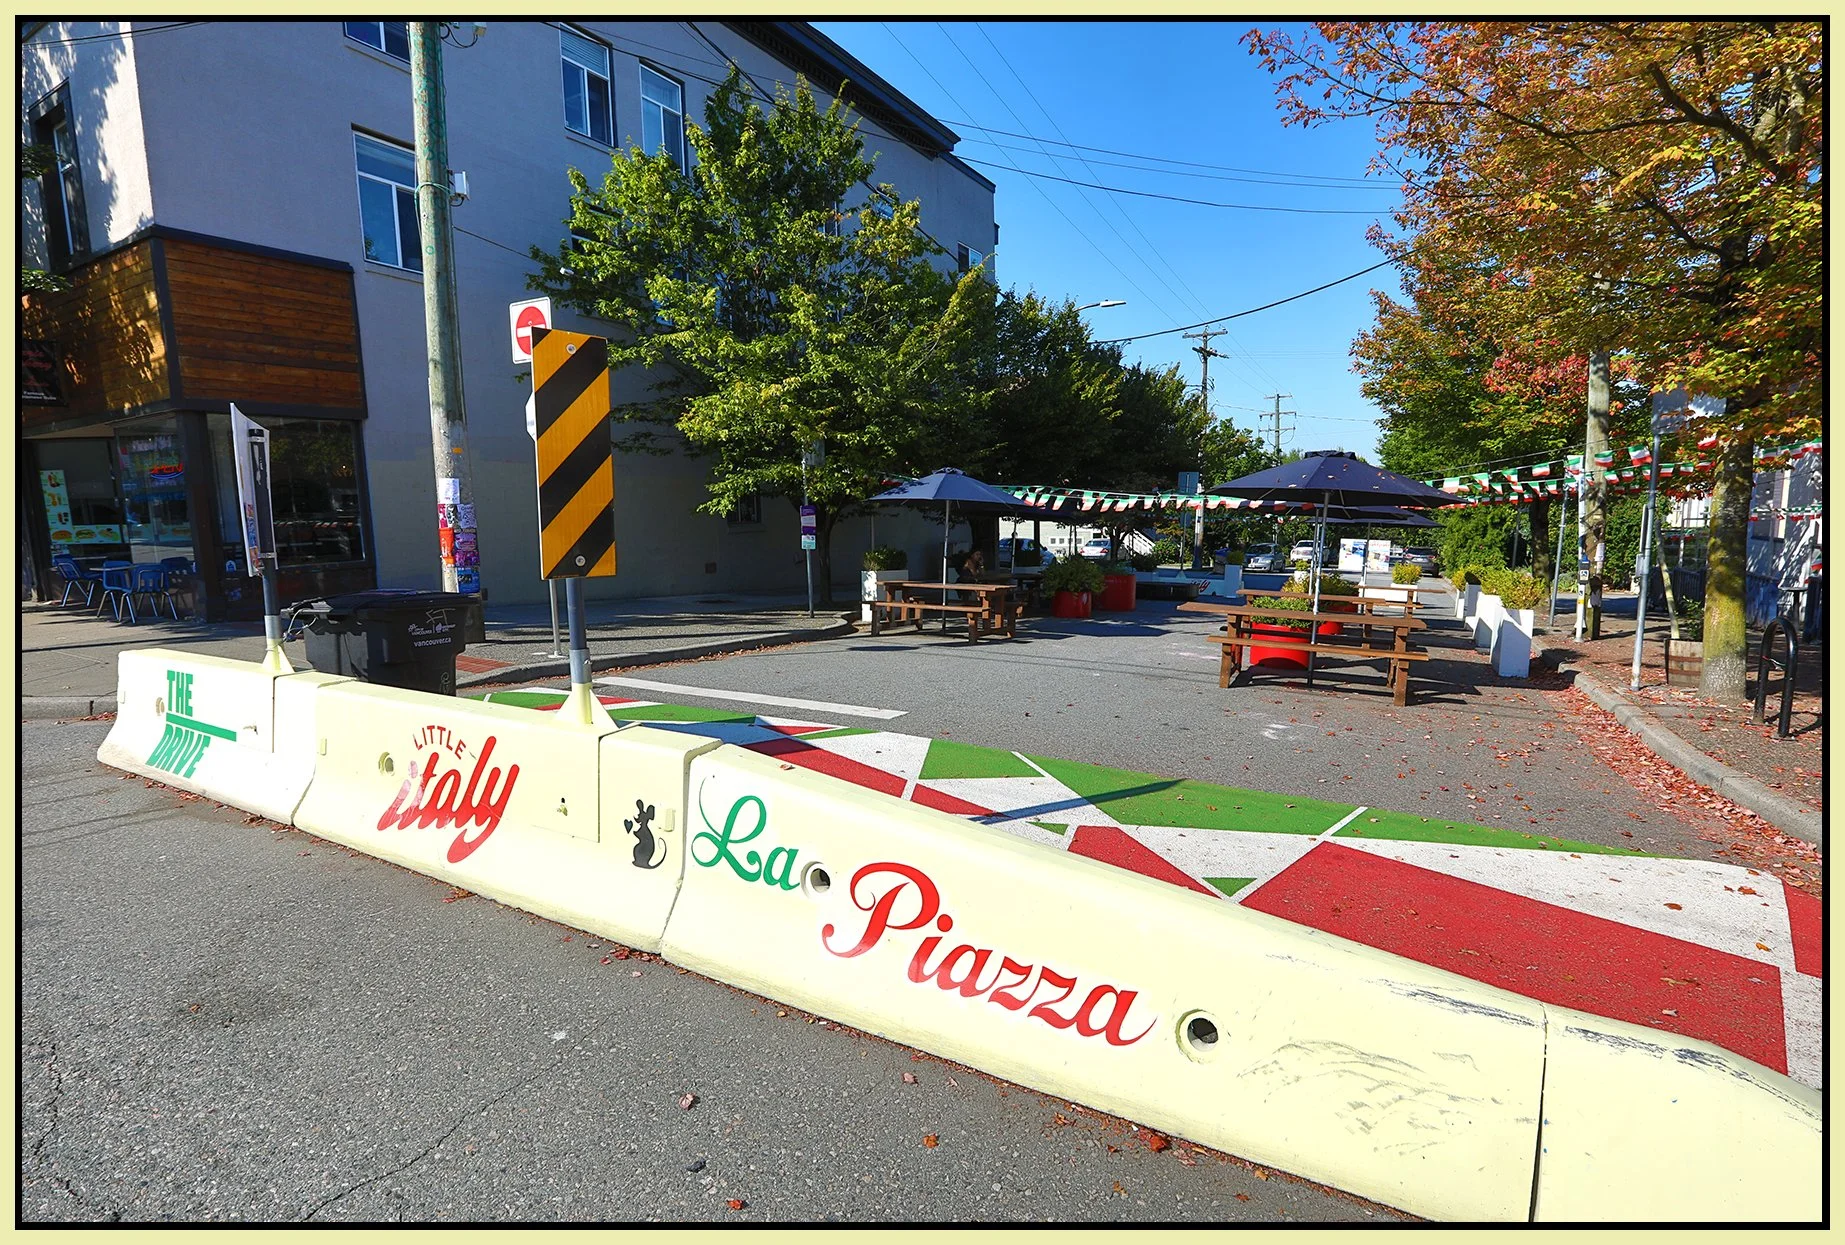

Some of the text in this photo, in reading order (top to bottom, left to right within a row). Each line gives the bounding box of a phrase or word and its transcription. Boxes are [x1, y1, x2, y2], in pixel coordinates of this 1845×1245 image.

[413, 637, 452, 647] vancouver.ca
[166, 669, 194, 717] THE
[144, 723, 211, 779] DRIVE
[412, 725, 467, 760] LITTLE
[690, 776, 1159, 1047] La Piazza
